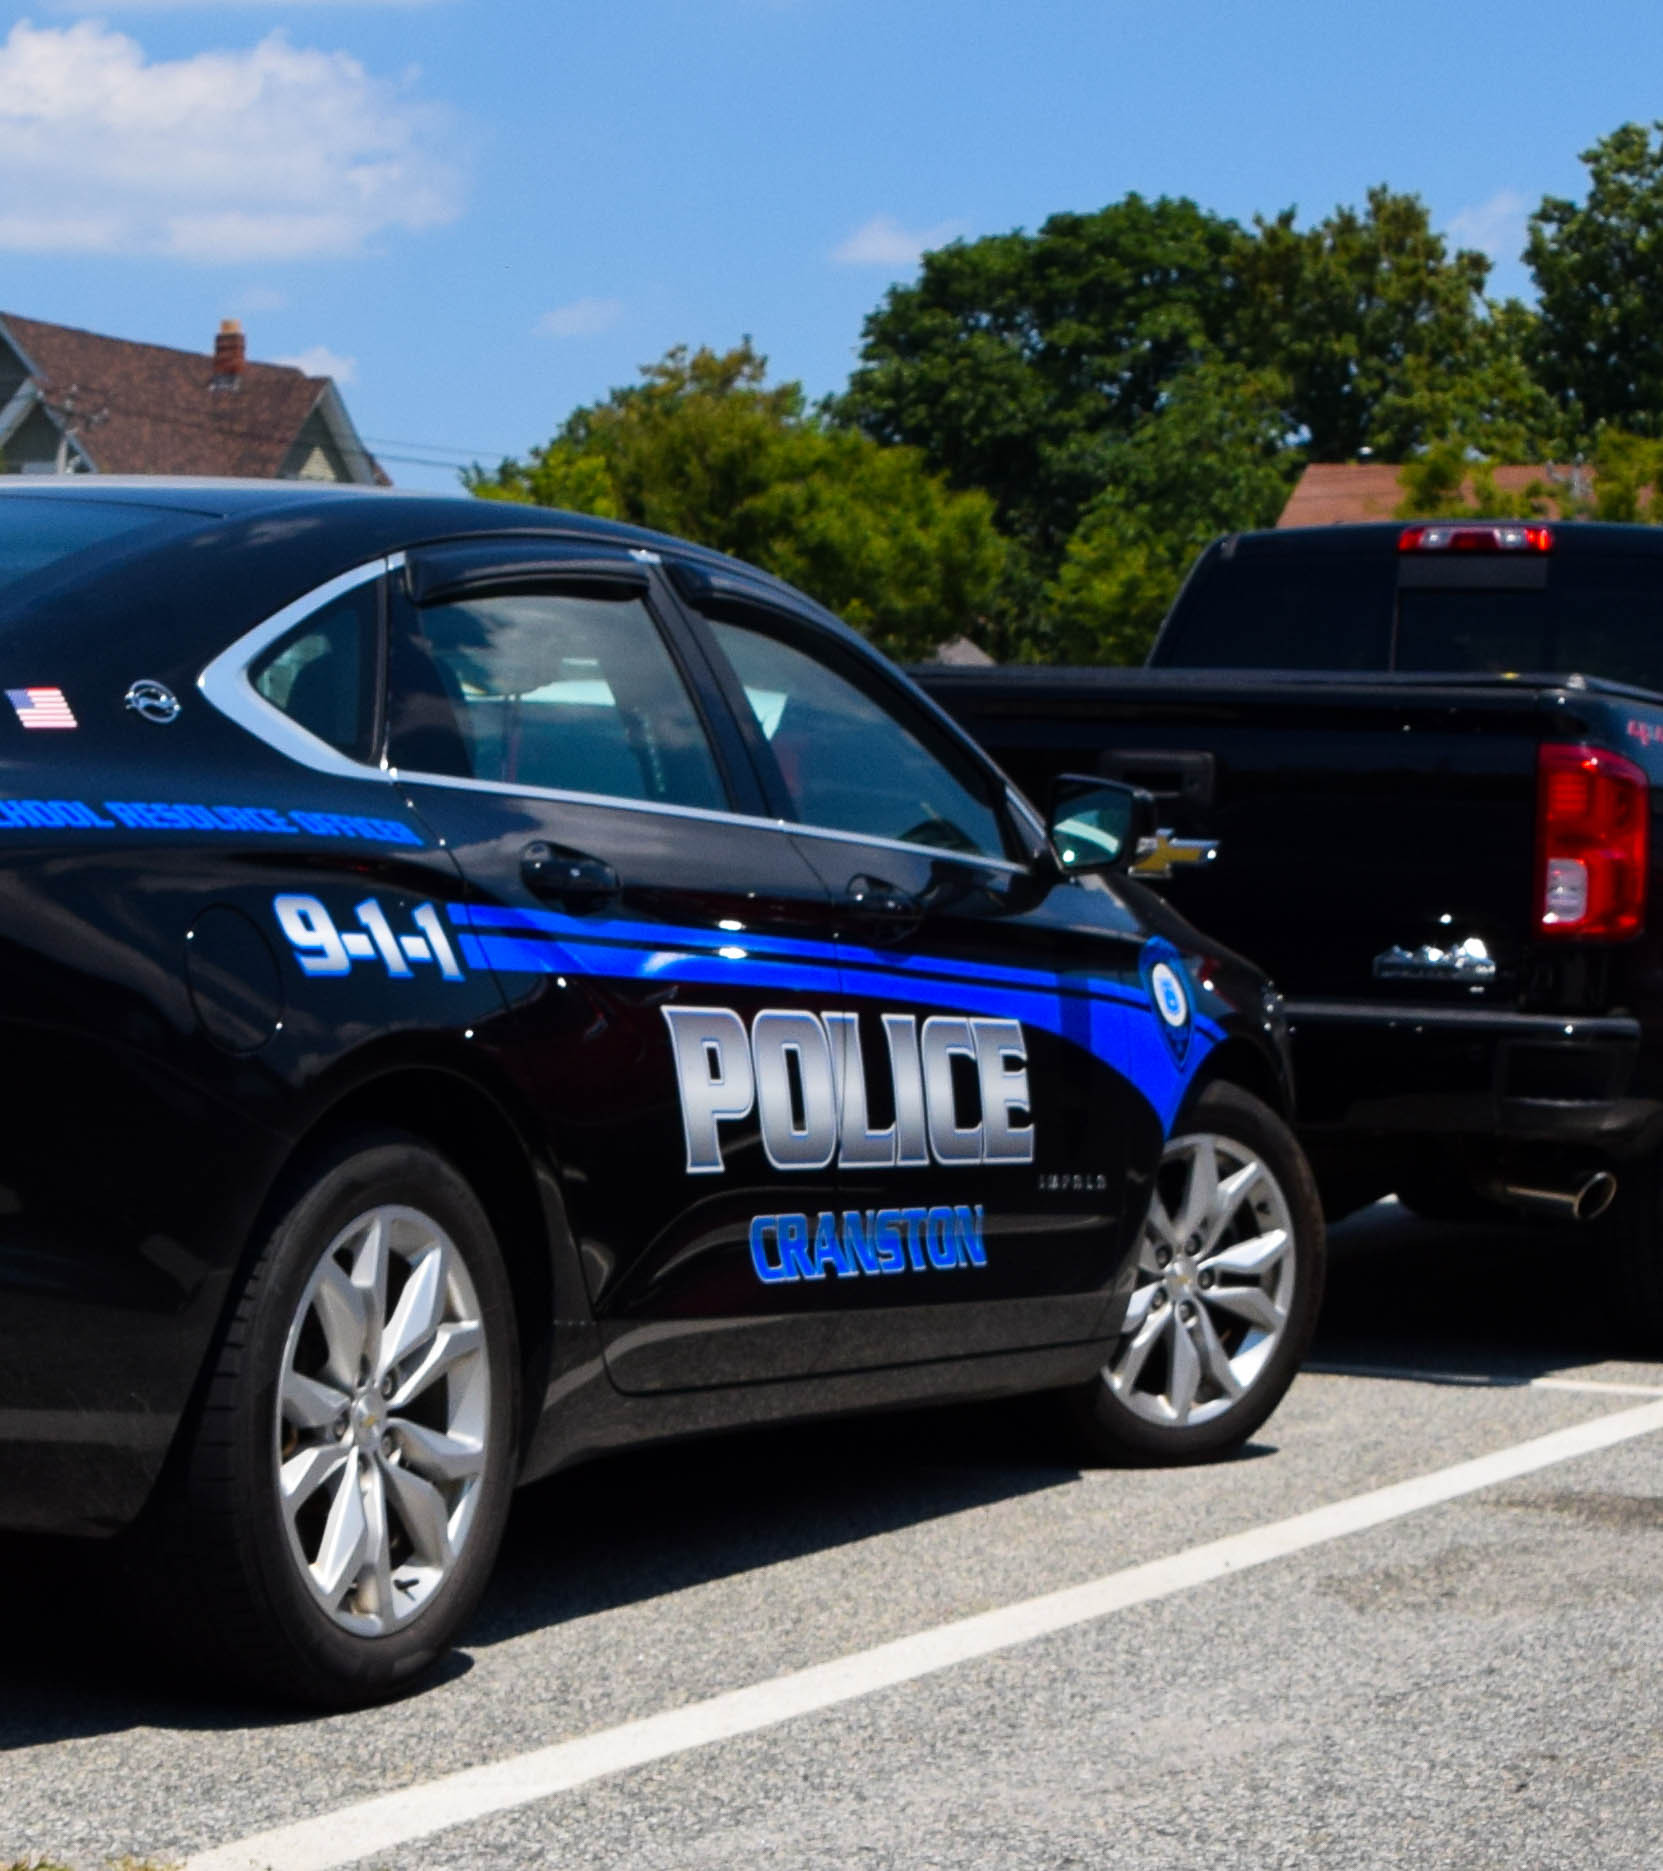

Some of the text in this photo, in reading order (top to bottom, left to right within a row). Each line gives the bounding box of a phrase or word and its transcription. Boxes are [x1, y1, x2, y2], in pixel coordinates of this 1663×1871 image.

[104, 802, 299, 833] RESOURCE
[287, 810, 425, 847] OFFICER
[273, 893, 466, 982] 9-1-1
[660, 1005, 1035, 1175] POLICE
[749, 1205, 988, 1284] CRANSTON
